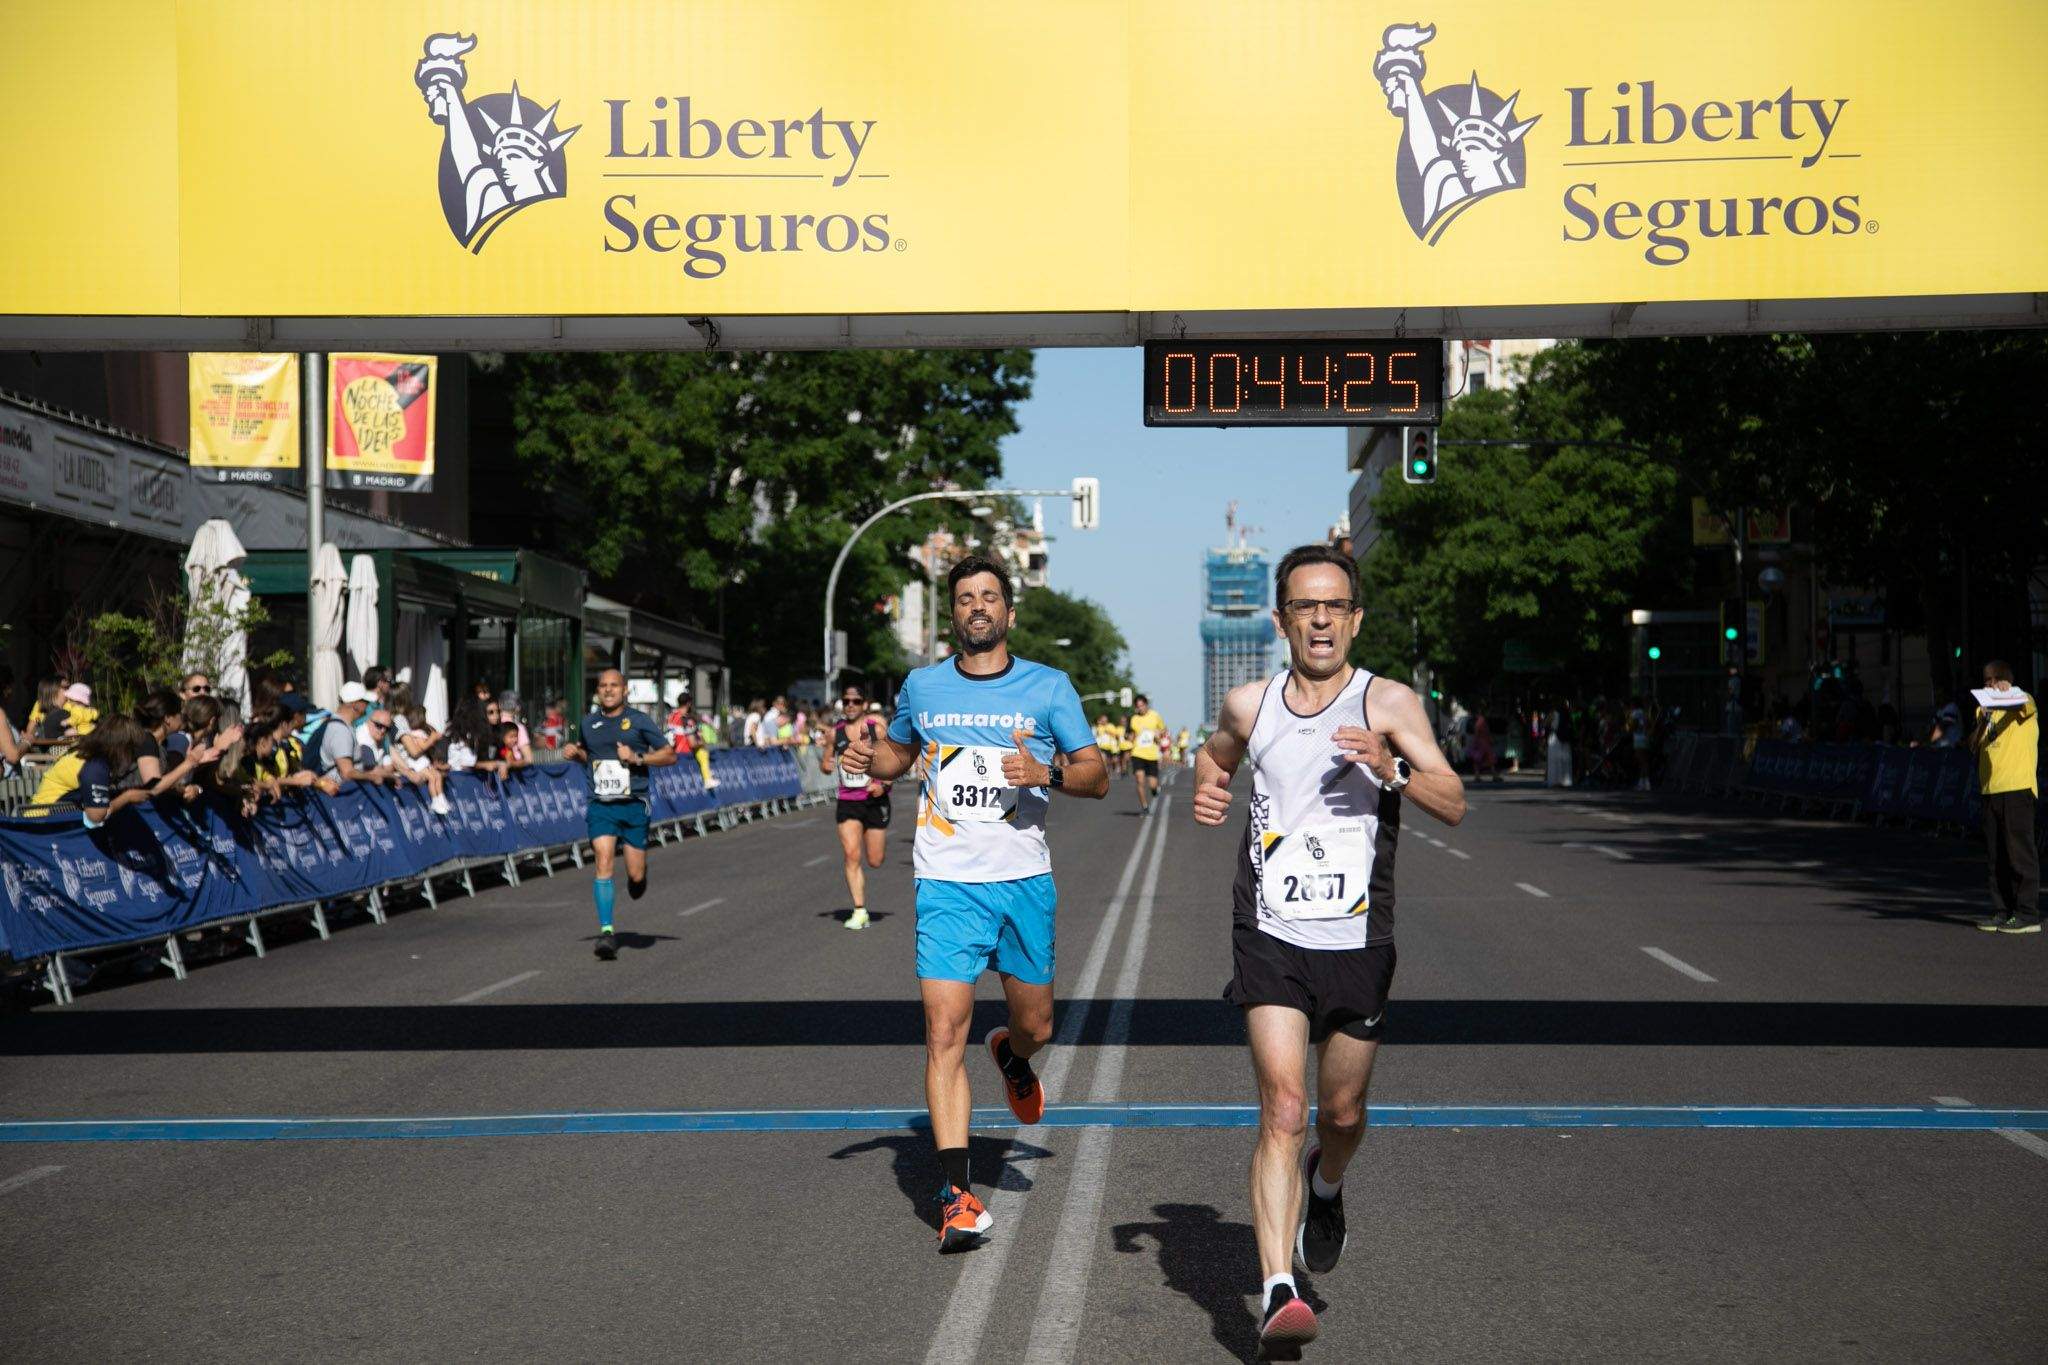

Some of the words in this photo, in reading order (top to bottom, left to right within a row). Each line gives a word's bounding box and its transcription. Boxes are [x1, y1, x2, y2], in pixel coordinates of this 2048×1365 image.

[1564, 80, 1850, 168] Liberty
[603, 96, 877, 187] Liberty
[603, 194, 890, 279] Seguros
[1563, 183, 1861, 266] Seguros
[1165, 353, 1419, 412] 00:44:25
[346, 387, 395, 412] NOCHE
[353, 410, 368, 424] DE
[372, 410, 401, 428] LAS
[0, 424, 32, 453] media
[359, 426, 402, 453] IDEAS
[230, 471, 273, 481] MADRID
[365, 476, 407, 488] MADRID
[952, 784, 1002, 809] 3312
[75, 856, 108, 885] Liberty
